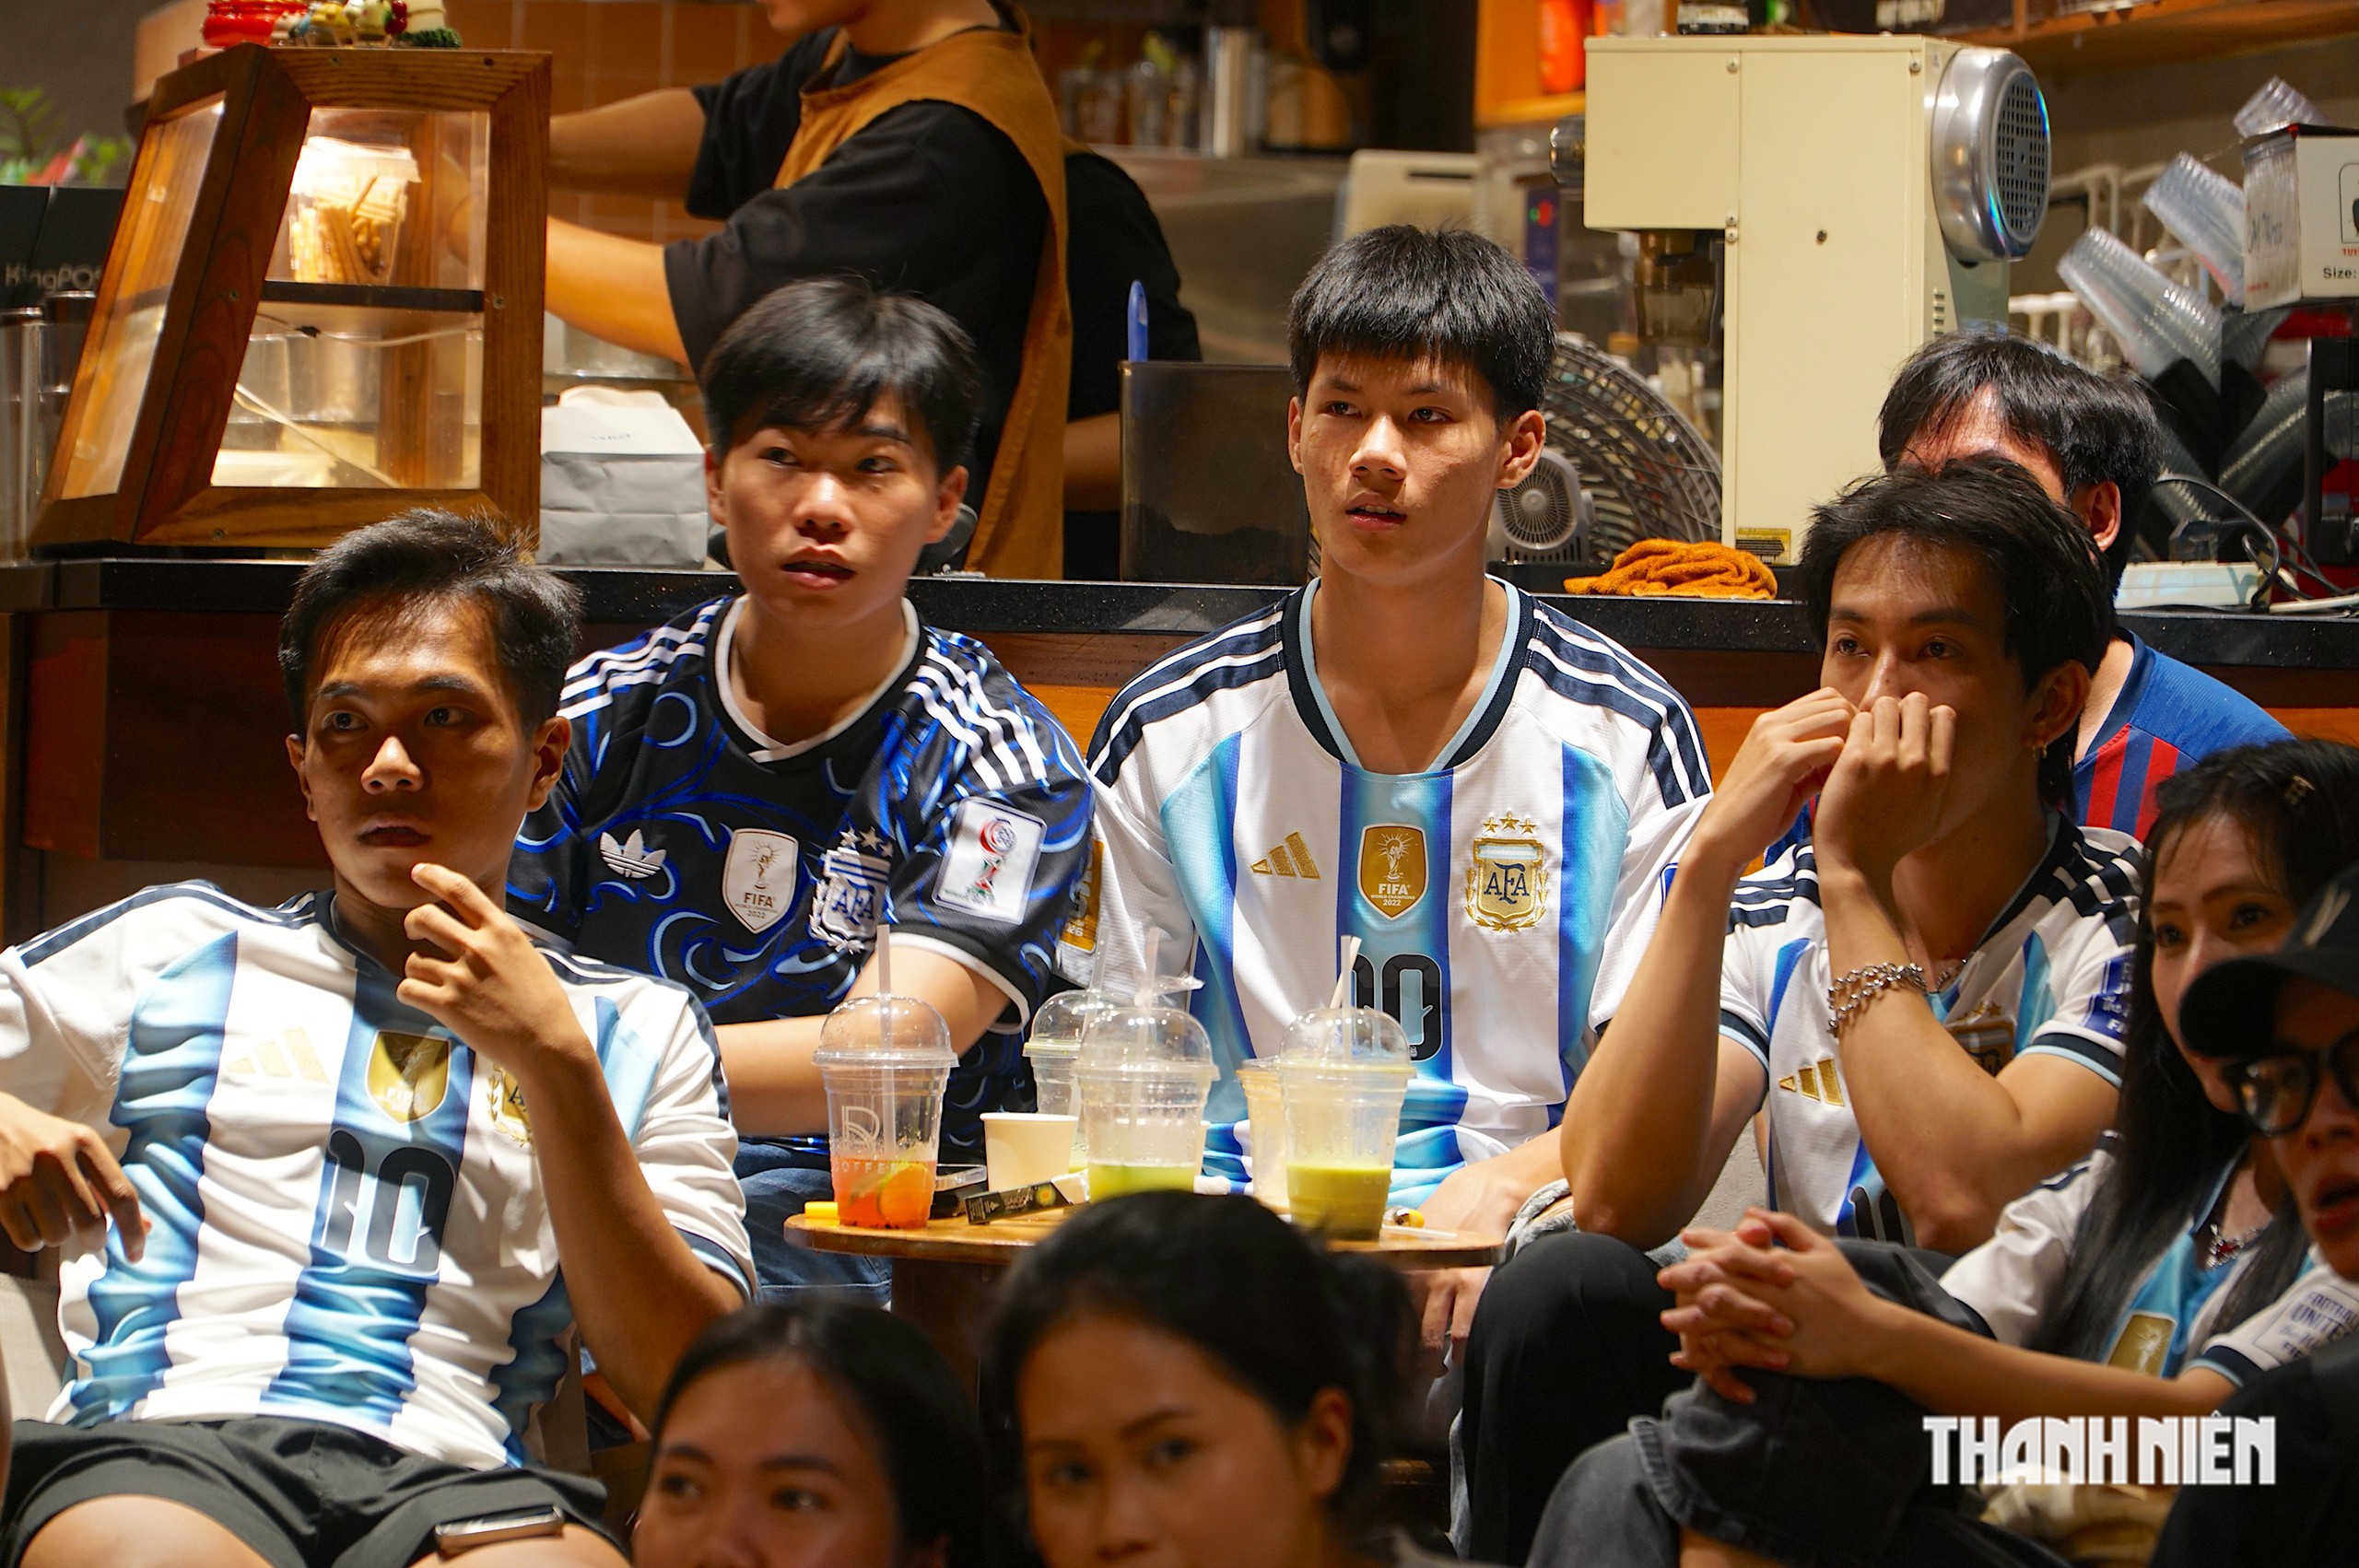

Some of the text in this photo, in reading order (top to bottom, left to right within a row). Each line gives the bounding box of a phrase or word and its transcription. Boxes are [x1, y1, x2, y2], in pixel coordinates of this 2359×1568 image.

[1379, 883, 1408, 895] FIFA
[1484, 861, 1530, 905] AFA
[744, 892, 773, 907] FIFA
[321, 1129, 456, 1275] 10
